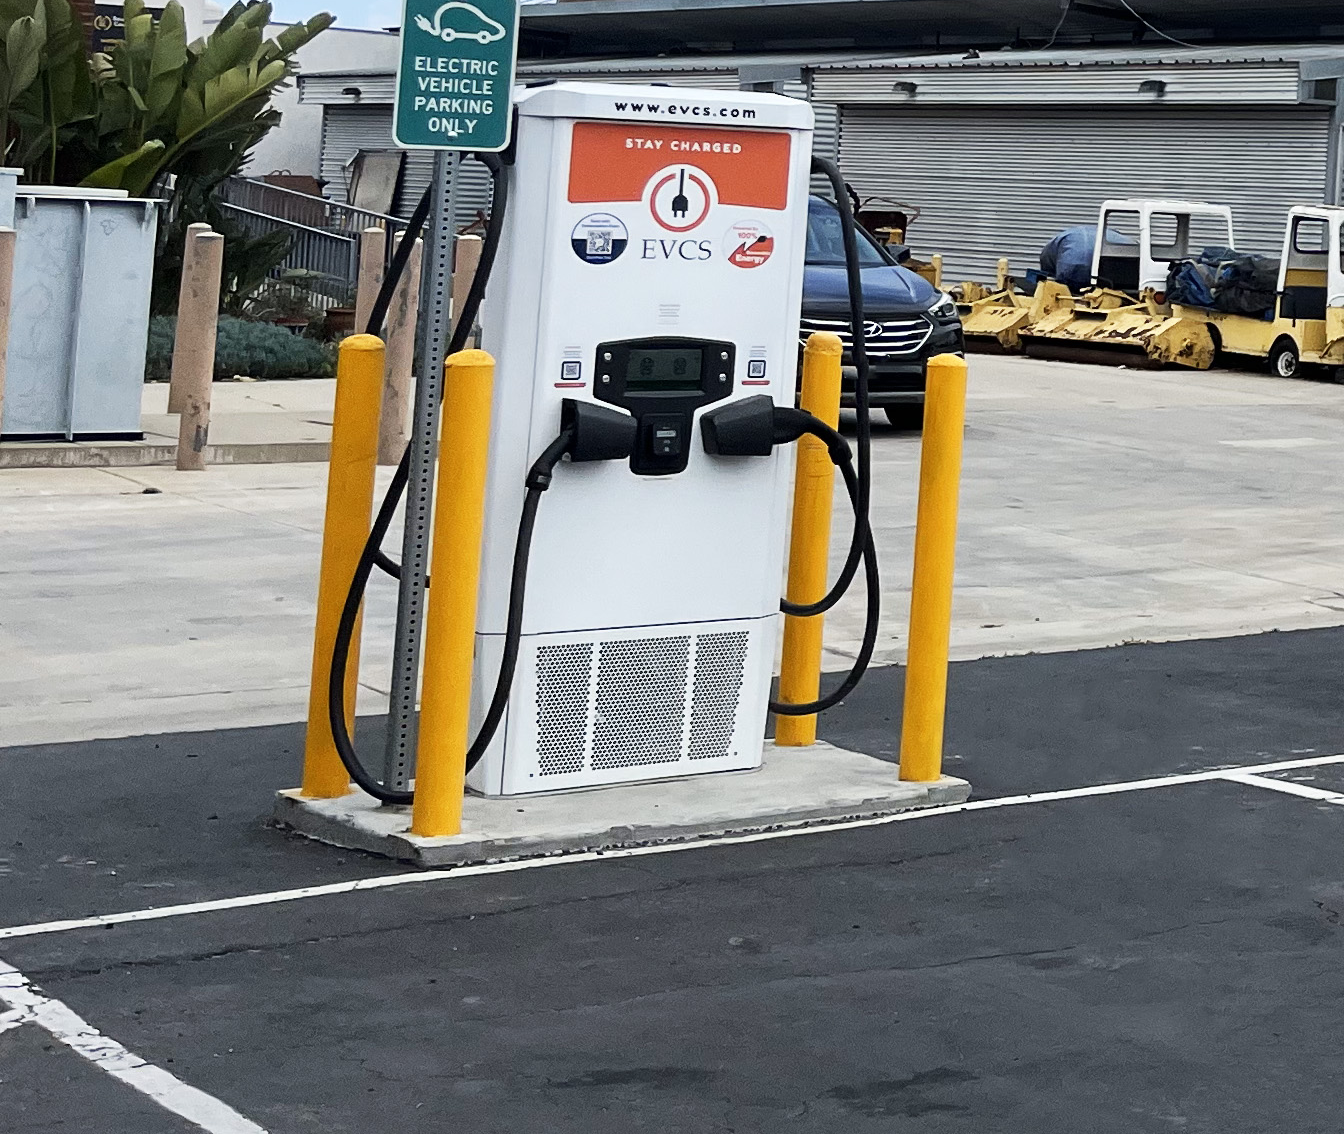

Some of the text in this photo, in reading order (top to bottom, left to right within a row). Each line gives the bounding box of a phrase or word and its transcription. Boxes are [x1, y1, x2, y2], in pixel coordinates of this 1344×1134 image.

[414, 56, 499, 75] ELECTRIC
[418, 77, 494, 95] VEHICLE
[414, 96, 494, 115] PARKING
[614, 102, 756, 119] www.evcs.com
[428, 117, 478, 134] ONLY
[625, 138, 742, 154] STAY CHARGED
[640, 239, 712, 261] EVCS
